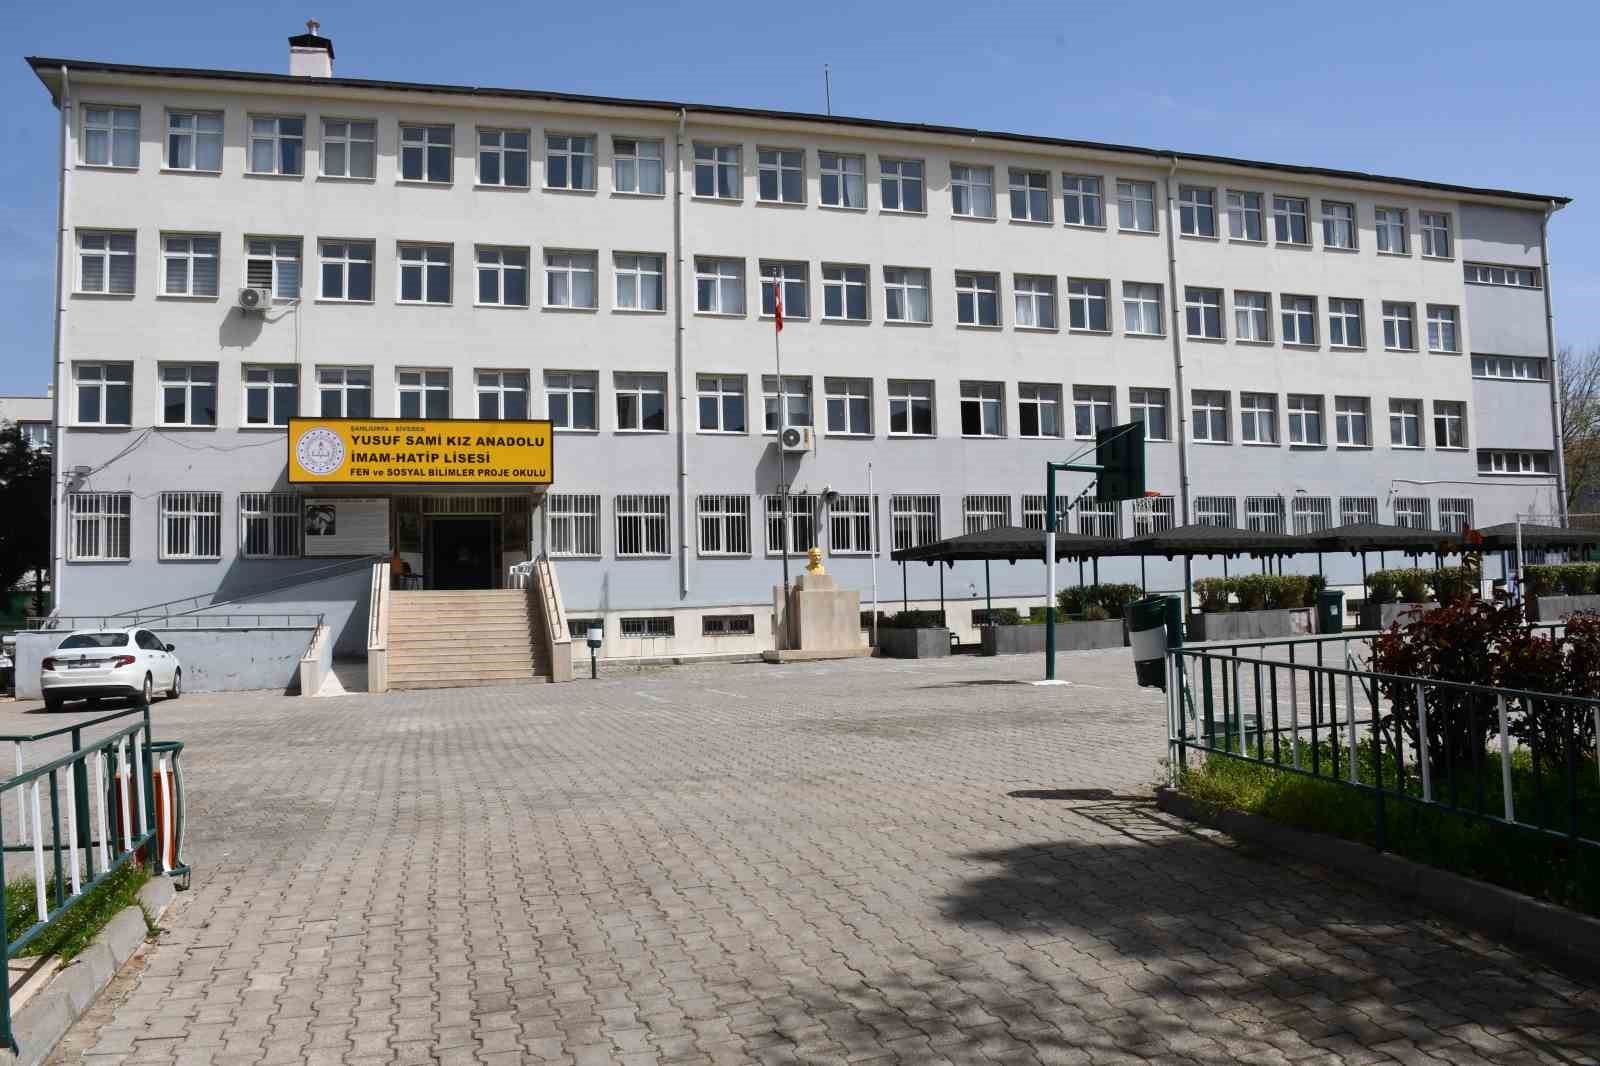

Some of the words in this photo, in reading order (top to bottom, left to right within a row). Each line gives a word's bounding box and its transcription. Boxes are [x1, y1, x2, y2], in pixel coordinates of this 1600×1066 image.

[351, 435, 401, 446] YUSUF
[406, 433, 441, 446] SAMİ
[446, 436, 471, 446] KIZ
[476, 436, 545, 447] ANADOLU
[351, 450, 439, 463] İMAM-HATİP
[444, 450, 490, 463] LİSESİ
[350, 468, 370, 476] FEN
[387, 468, 426, 476] SOSYAL
[428, 467, 475, 477] BİLİMLER
[478, 468, 510, 477] PROJE
[512, 468, 546, 477] OKULU
